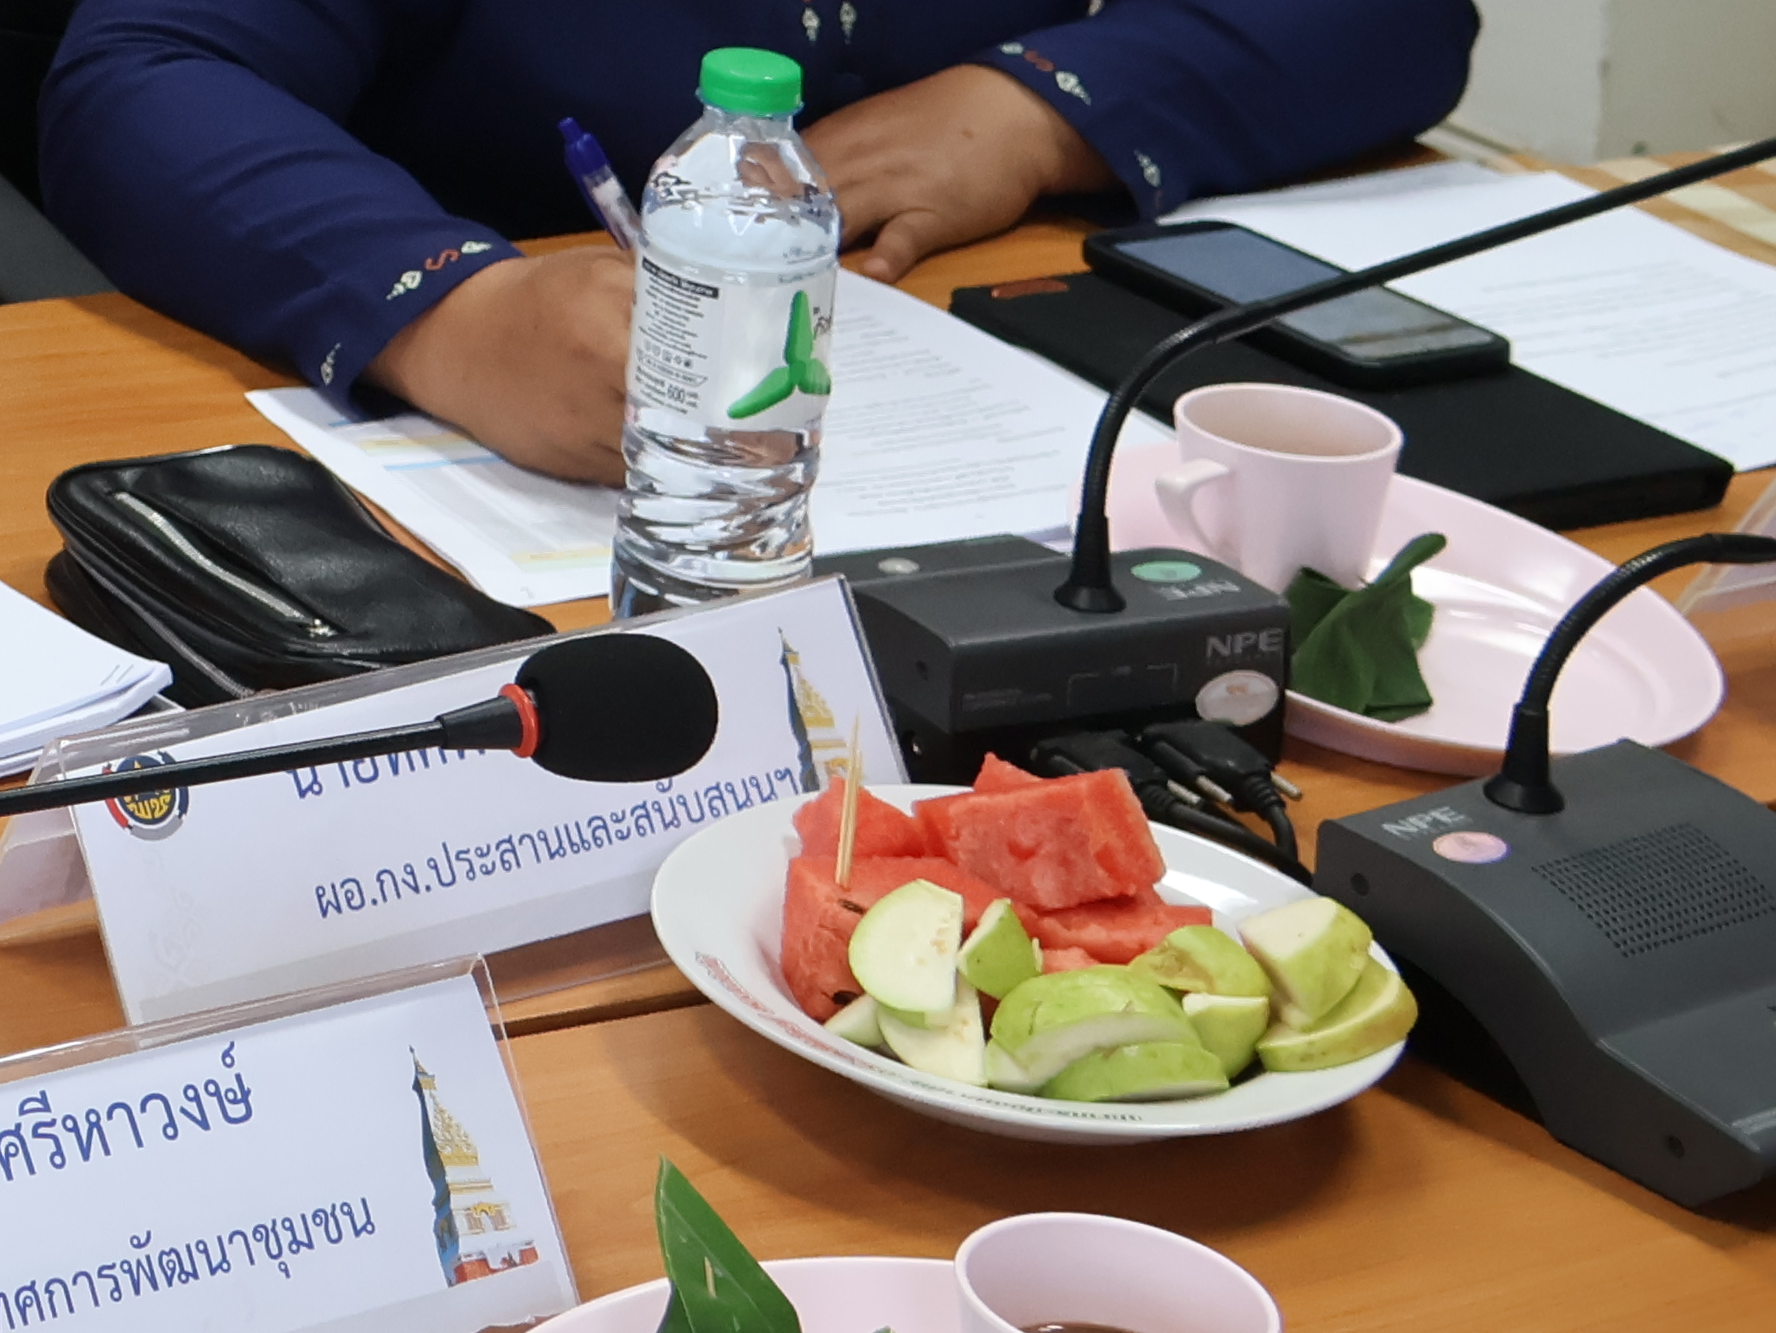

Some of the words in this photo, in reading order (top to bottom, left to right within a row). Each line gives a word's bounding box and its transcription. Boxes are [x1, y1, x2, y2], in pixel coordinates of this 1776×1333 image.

[1204, 627, 1285, 660] NPE
[1381, 804, 1466, 838] NPE
[314, 767, 801, 920] ผอ.กง.ประสานและสนับสนนฯ
